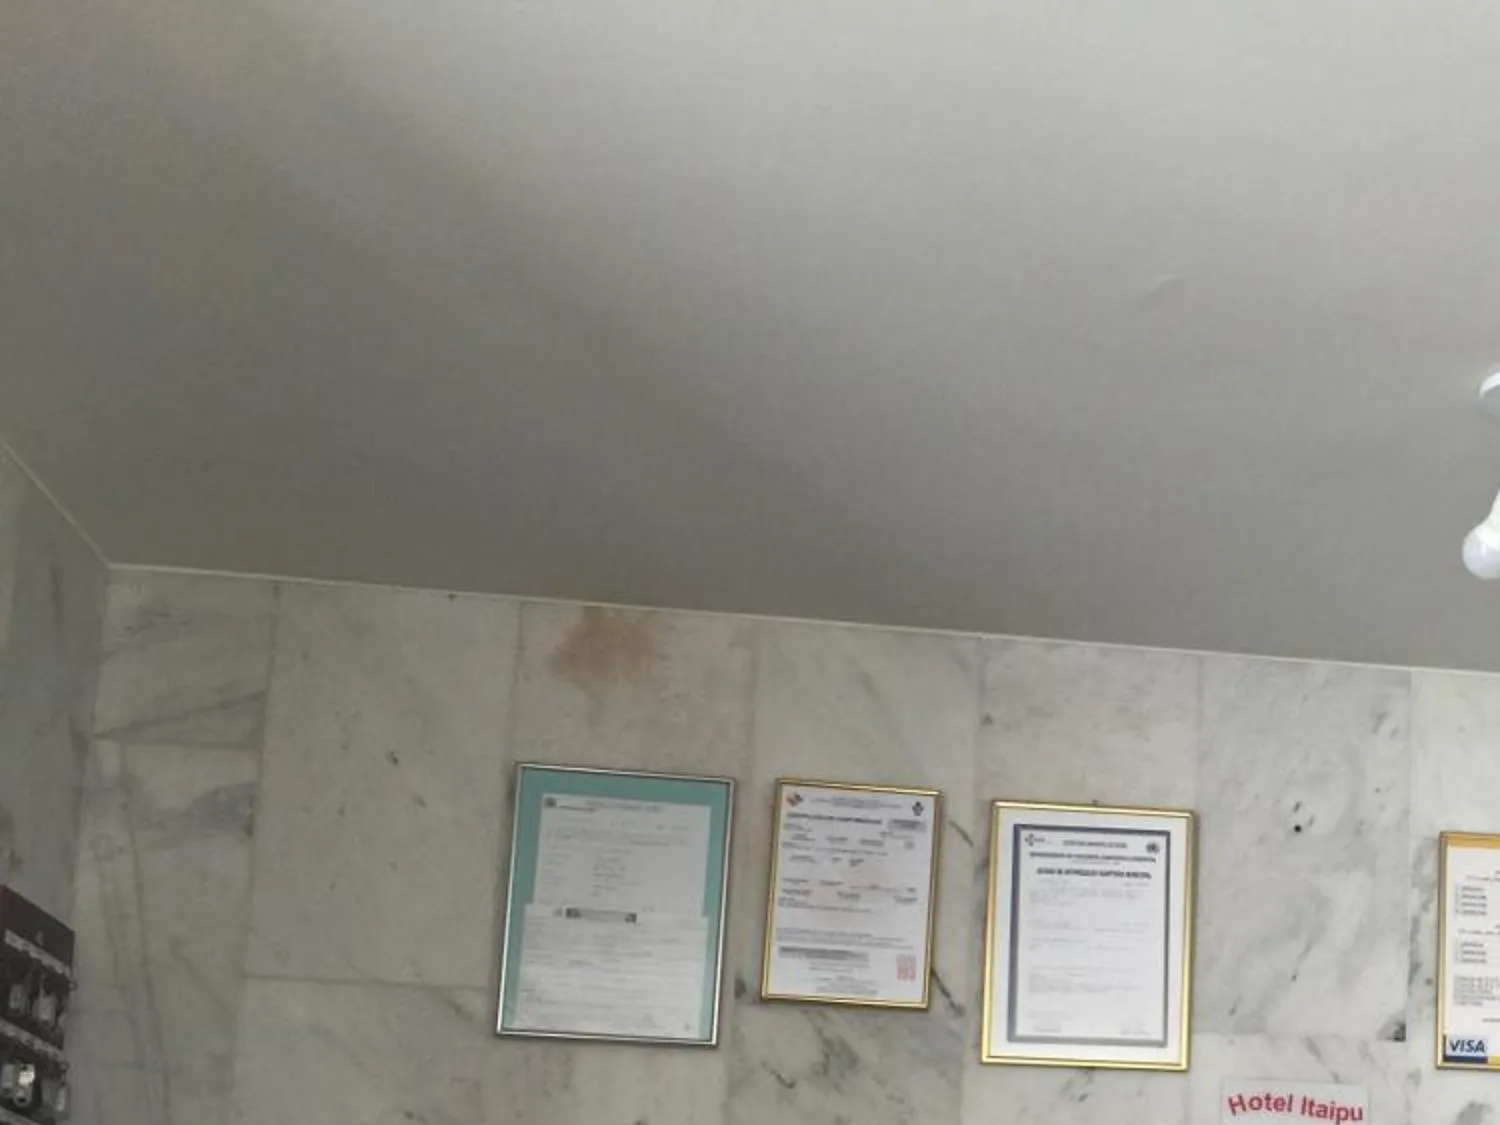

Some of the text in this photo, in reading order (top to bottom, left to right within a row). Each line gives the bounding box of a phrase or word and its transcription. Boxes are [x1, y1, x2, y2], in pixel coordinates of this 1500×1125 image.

[1449, 1039, 1486, 1053] VISA
[1228, 1092, 1363, 1125] Hotel Itaipu
